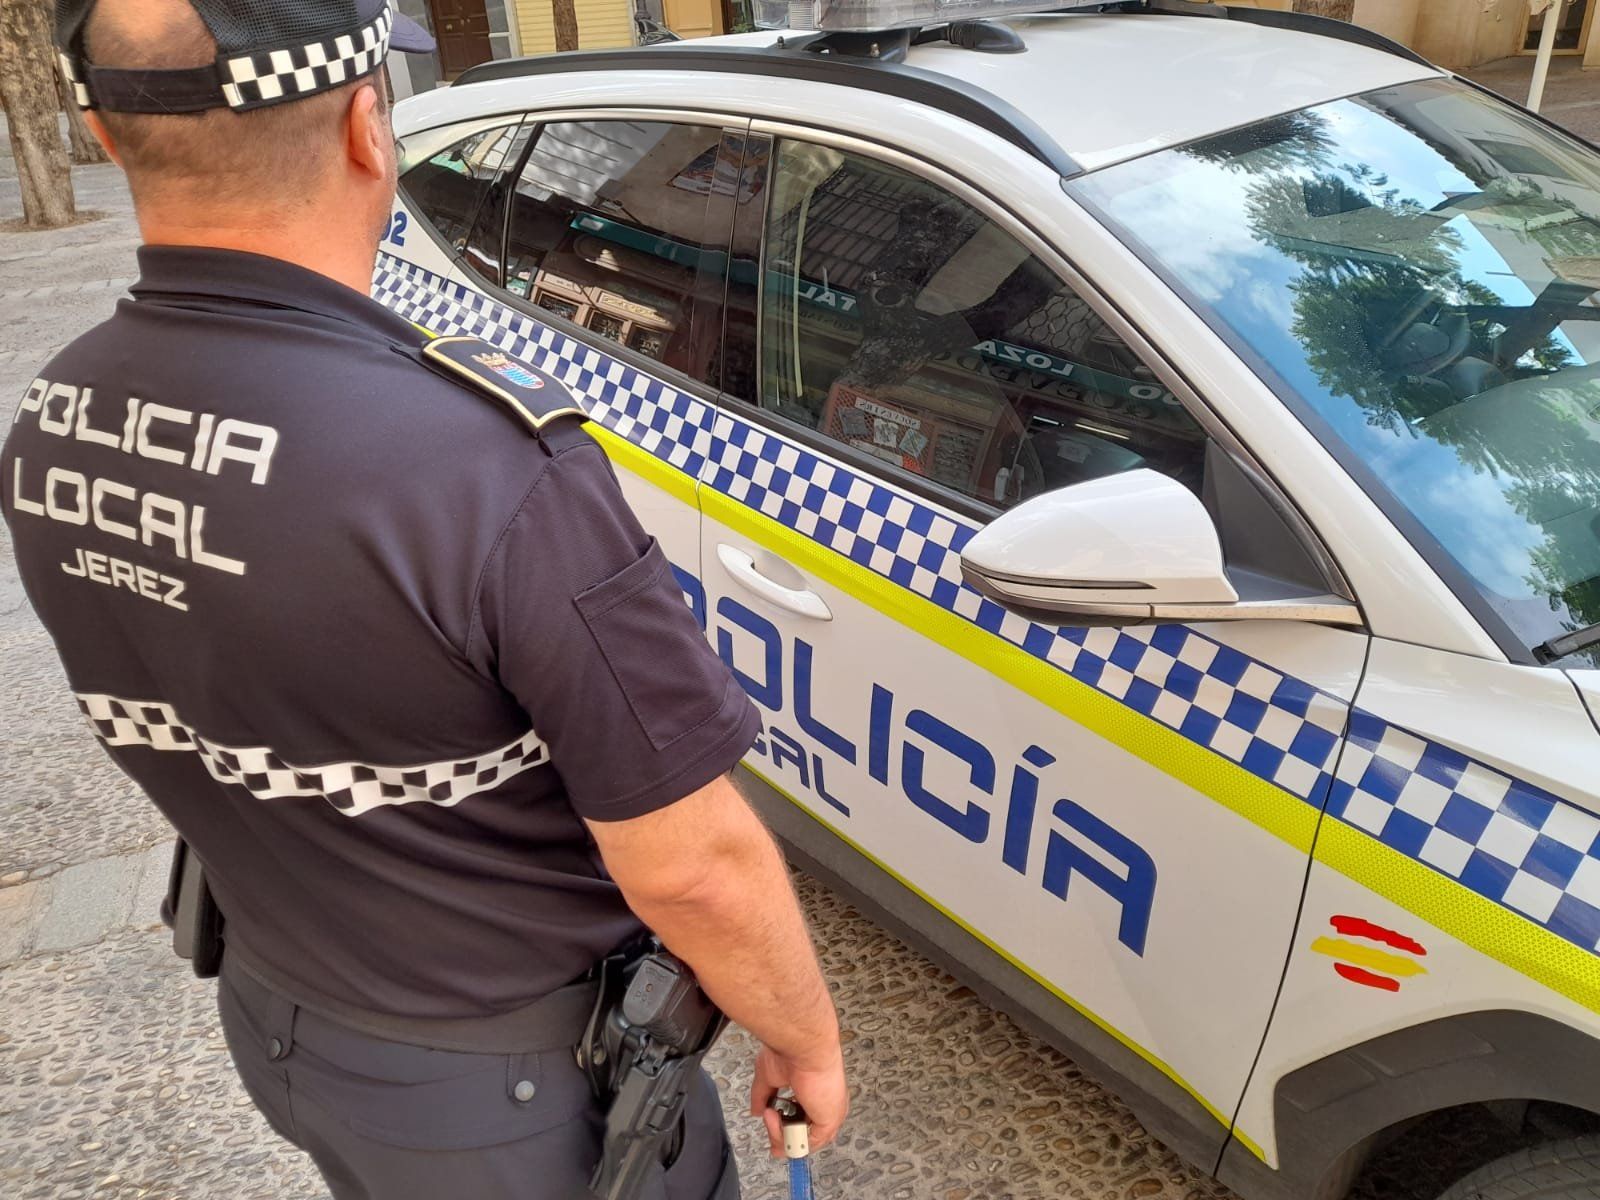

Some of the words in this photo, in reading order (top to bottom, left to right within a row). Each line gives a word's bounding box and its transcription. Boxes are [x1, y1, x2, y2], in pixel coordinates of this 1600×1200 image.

[13, 378, 279, 485] POLICIA
[14, 456, 246, 576] LOCAL
[61, 548, 189, 611] JEREZ
